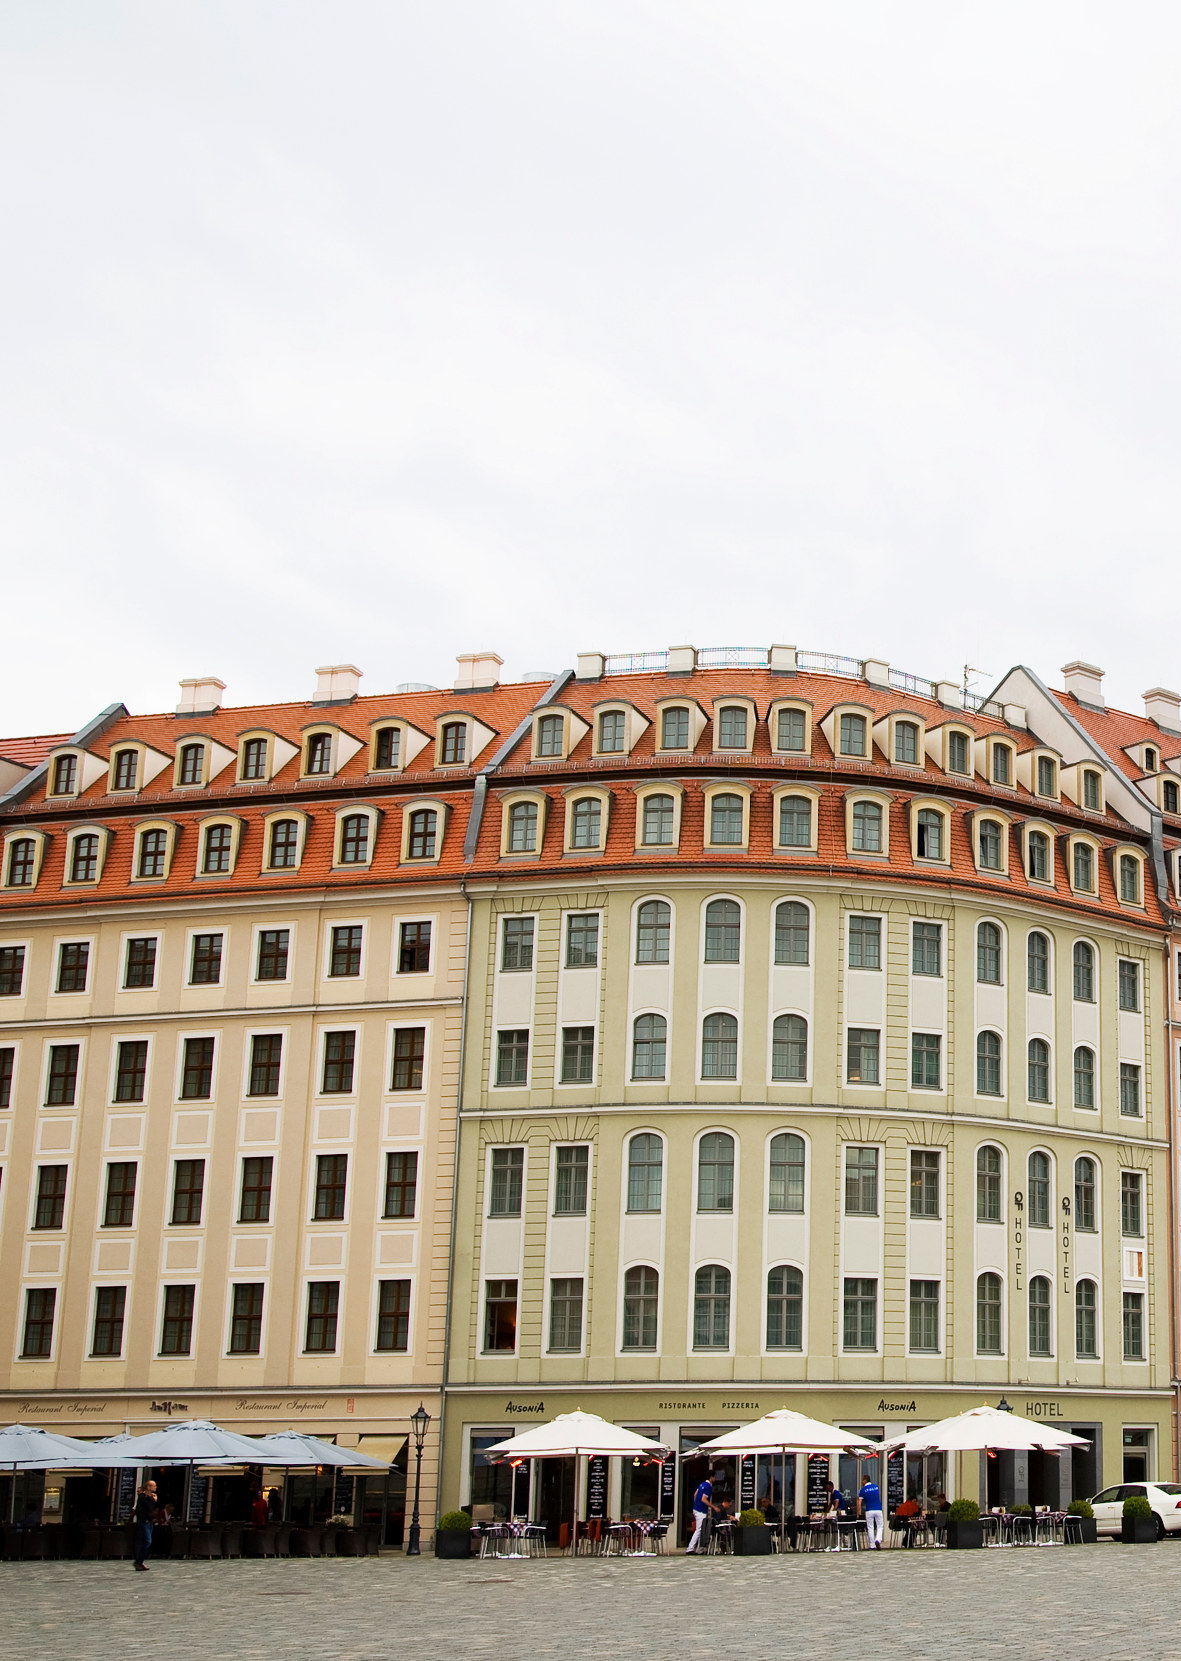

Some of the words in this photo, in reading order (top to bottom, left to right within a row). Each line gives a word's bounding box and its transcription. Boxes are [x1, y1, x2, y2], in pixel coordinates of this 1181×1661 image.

[18, 1402, 63, 1414] Restaurant
[66, 1402, 107, 1417] Imperial
[235, 1398, 282, 1411] Restaurant
[286, 1399, 329, 1413] Imperial
[1026, 1402, 1064, 1417] HOTEL
